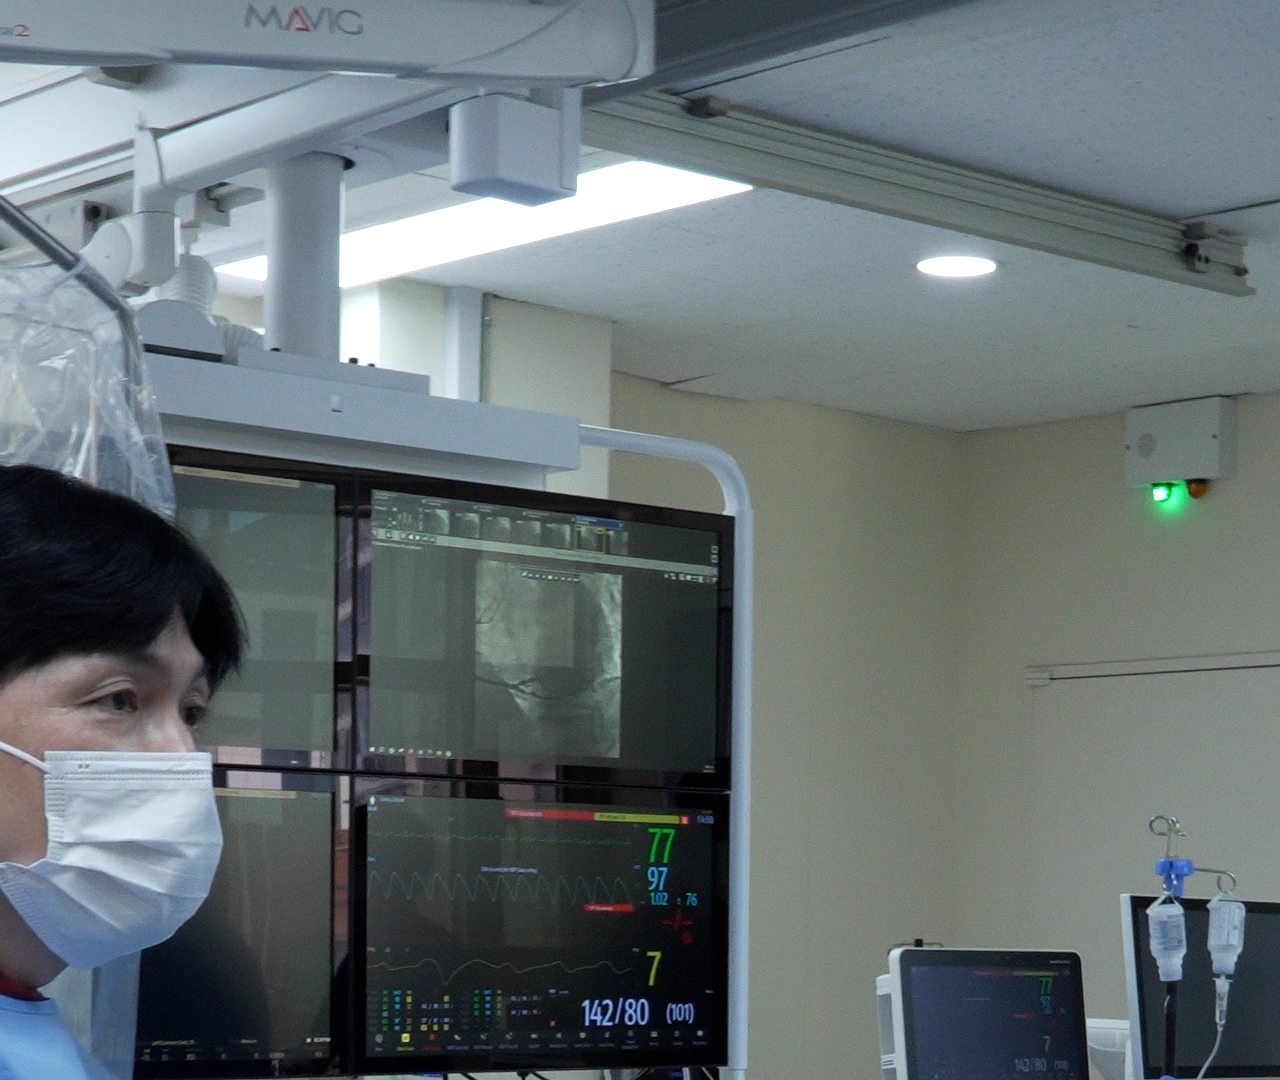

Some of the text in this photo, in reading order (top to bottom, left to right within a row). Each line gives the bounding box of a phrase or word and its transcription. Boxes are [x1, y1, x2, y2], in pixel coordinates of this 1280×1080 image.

[243, 4, 364, 35] MAVIG
[647, 827, 676, 863] 77
[647, 866, 669, 891] 97
[646, 951, 662, 986] 7
[581, 997, 695, 1027] 142/80 (101)
